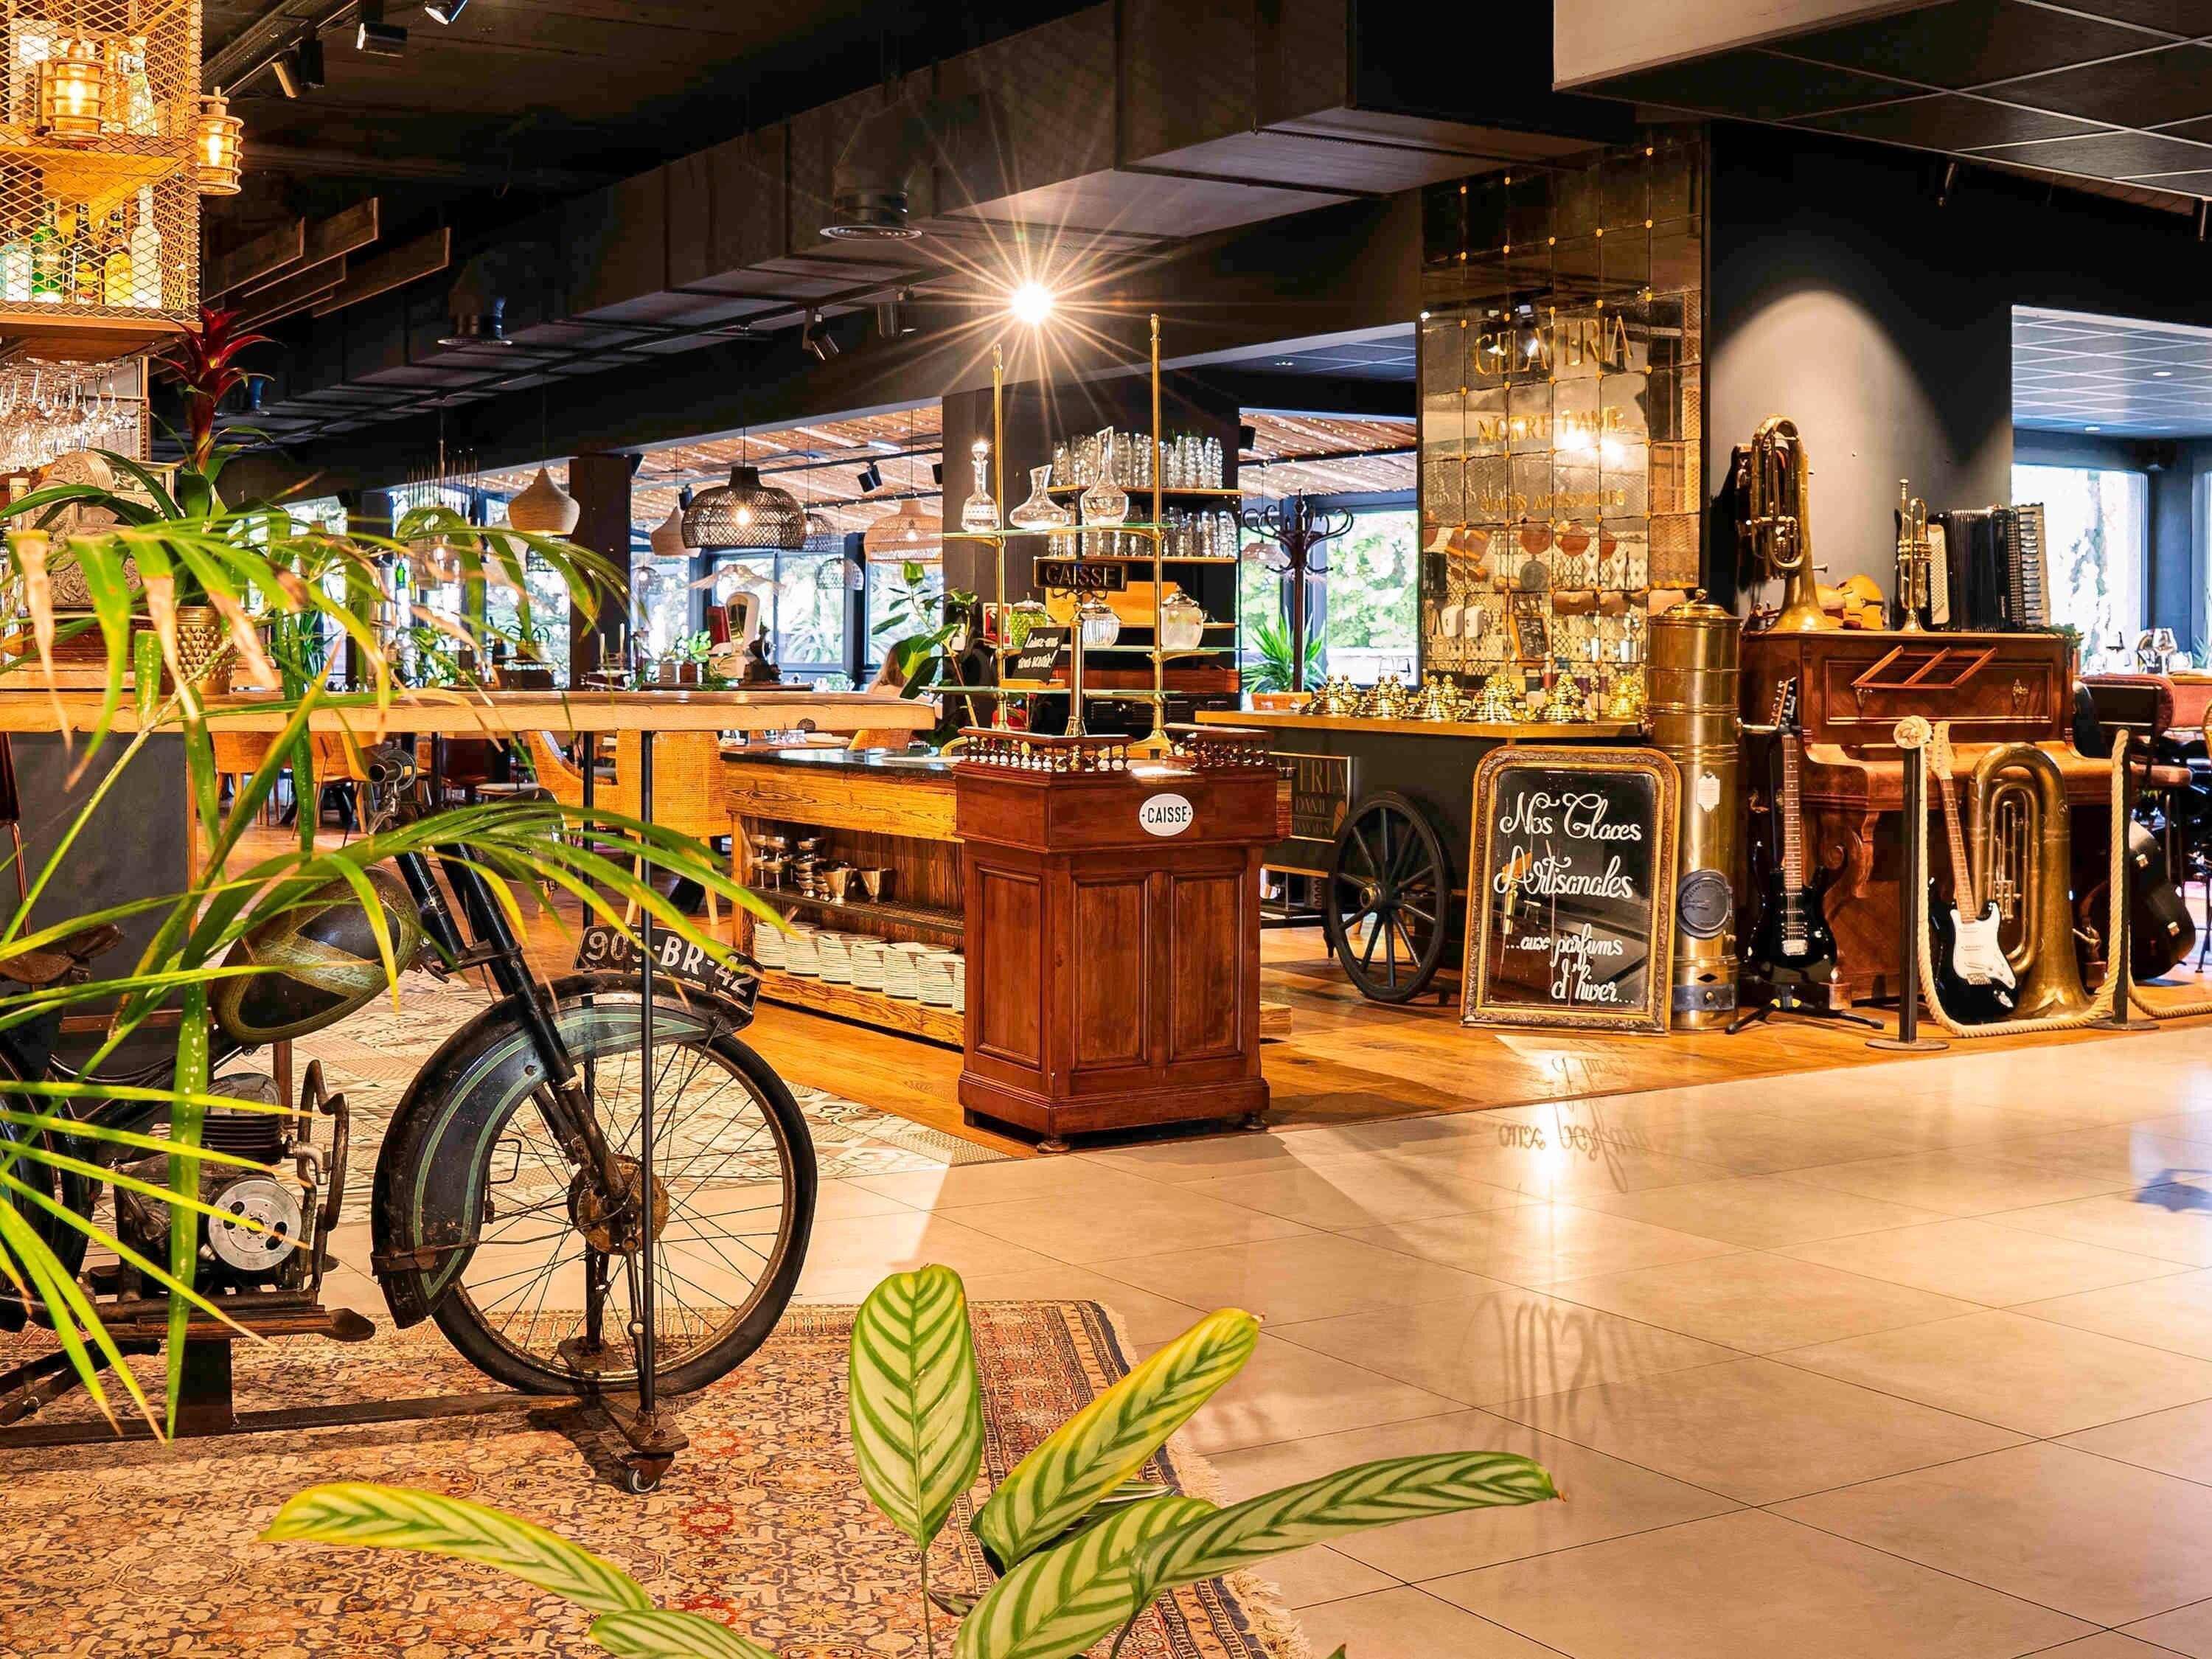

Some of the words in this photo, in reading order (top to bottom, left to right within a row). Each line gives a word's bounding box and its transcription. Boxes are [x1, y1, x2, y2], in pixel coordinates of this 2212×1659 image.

[1475, 316, 1633, 376] GELATERIA
[1478, 412, 1551, 444] NOTRE
[1046, 564, 1116, 588] CAISSE
[1147, 805, 1188, 824] CAISSE
[1499, 791, 1560, 835] Nos
[1562, 793, 1642, 841] Glaces
[1493, 845, 1634, 899] Artisanales
[1549, 922, 1624, 972] parfums
